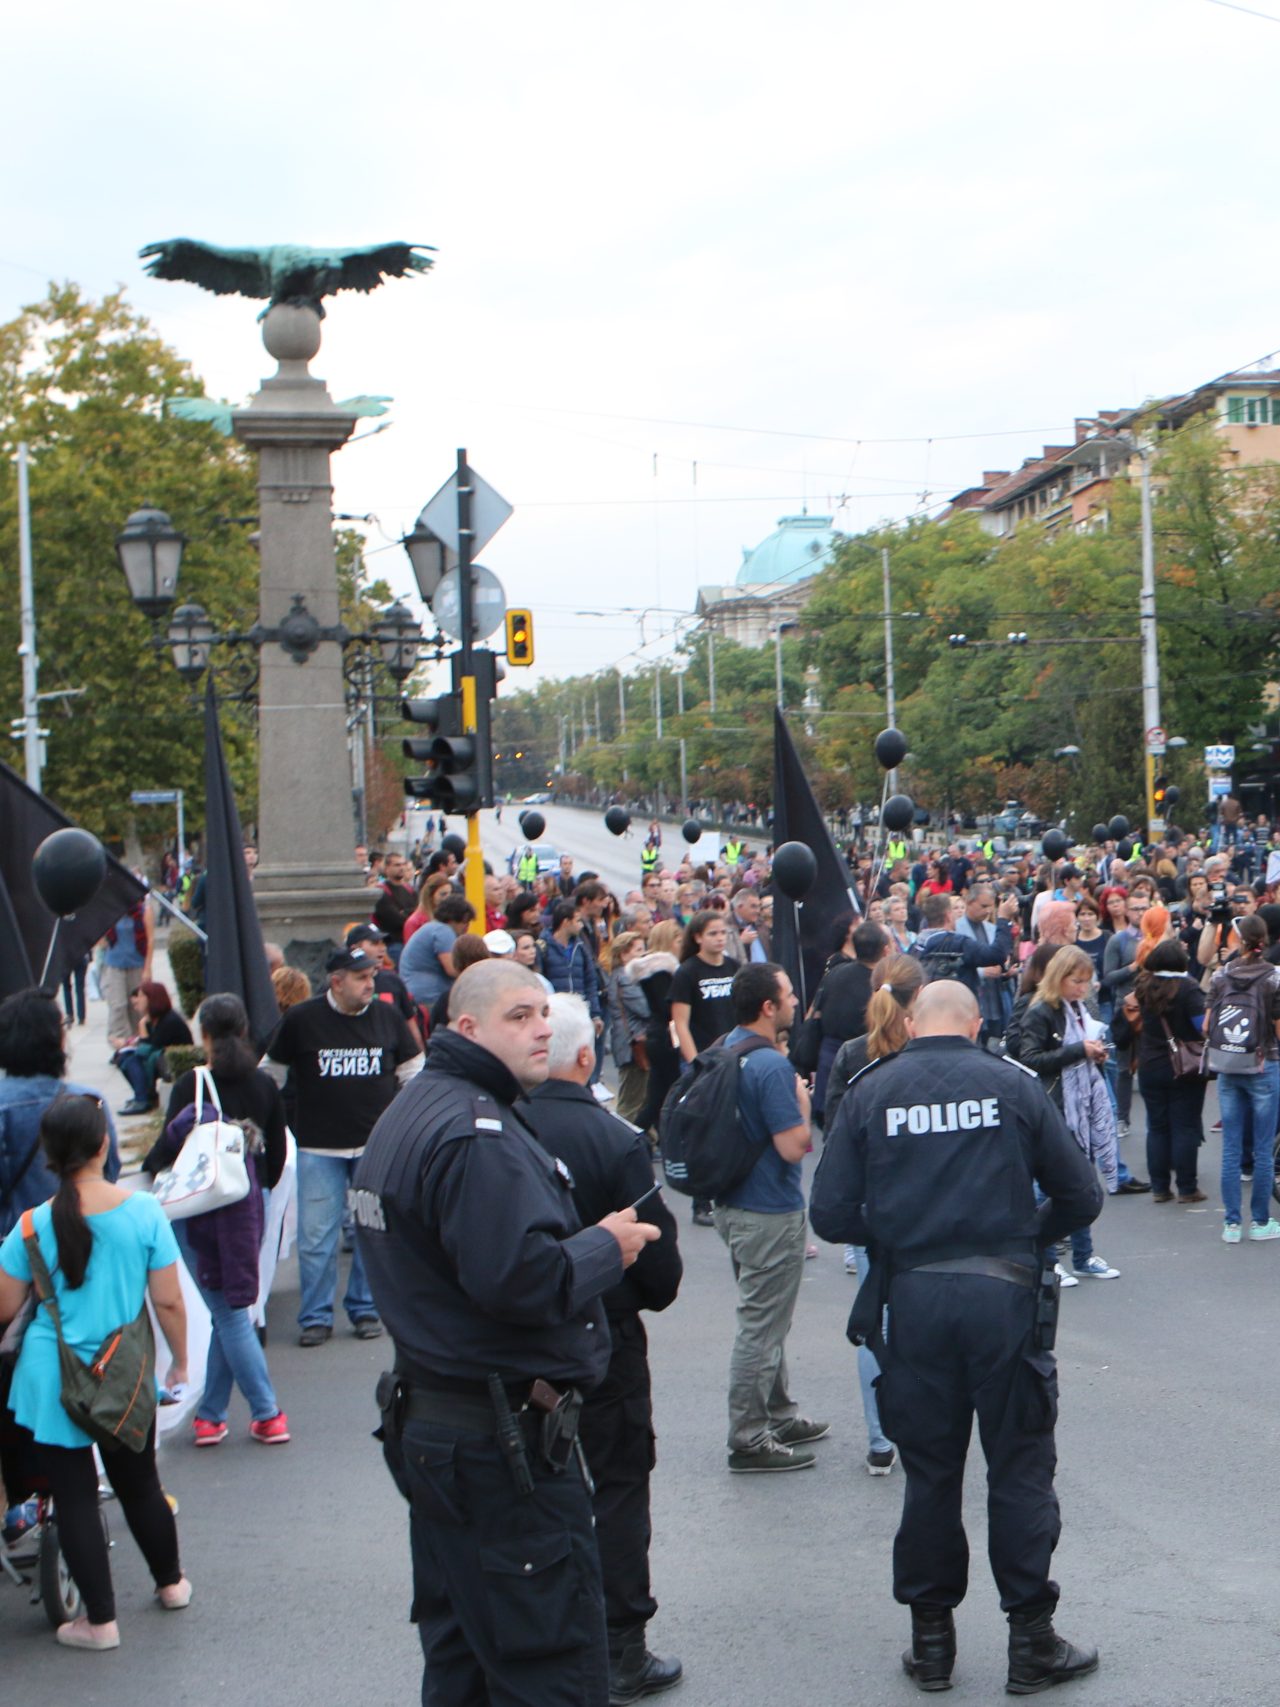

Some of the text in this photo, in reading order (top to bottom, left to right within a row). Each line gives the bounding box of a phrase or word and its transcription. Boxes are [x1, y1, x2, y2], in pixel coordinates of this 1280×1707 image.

[700, 983, 732, 999] УБИ
[1220, 1044, 1247, 1053] adidas
[318, 1057, 381, 1076] УБИВА
[886, 1098, 1001, 1136] POLICE
